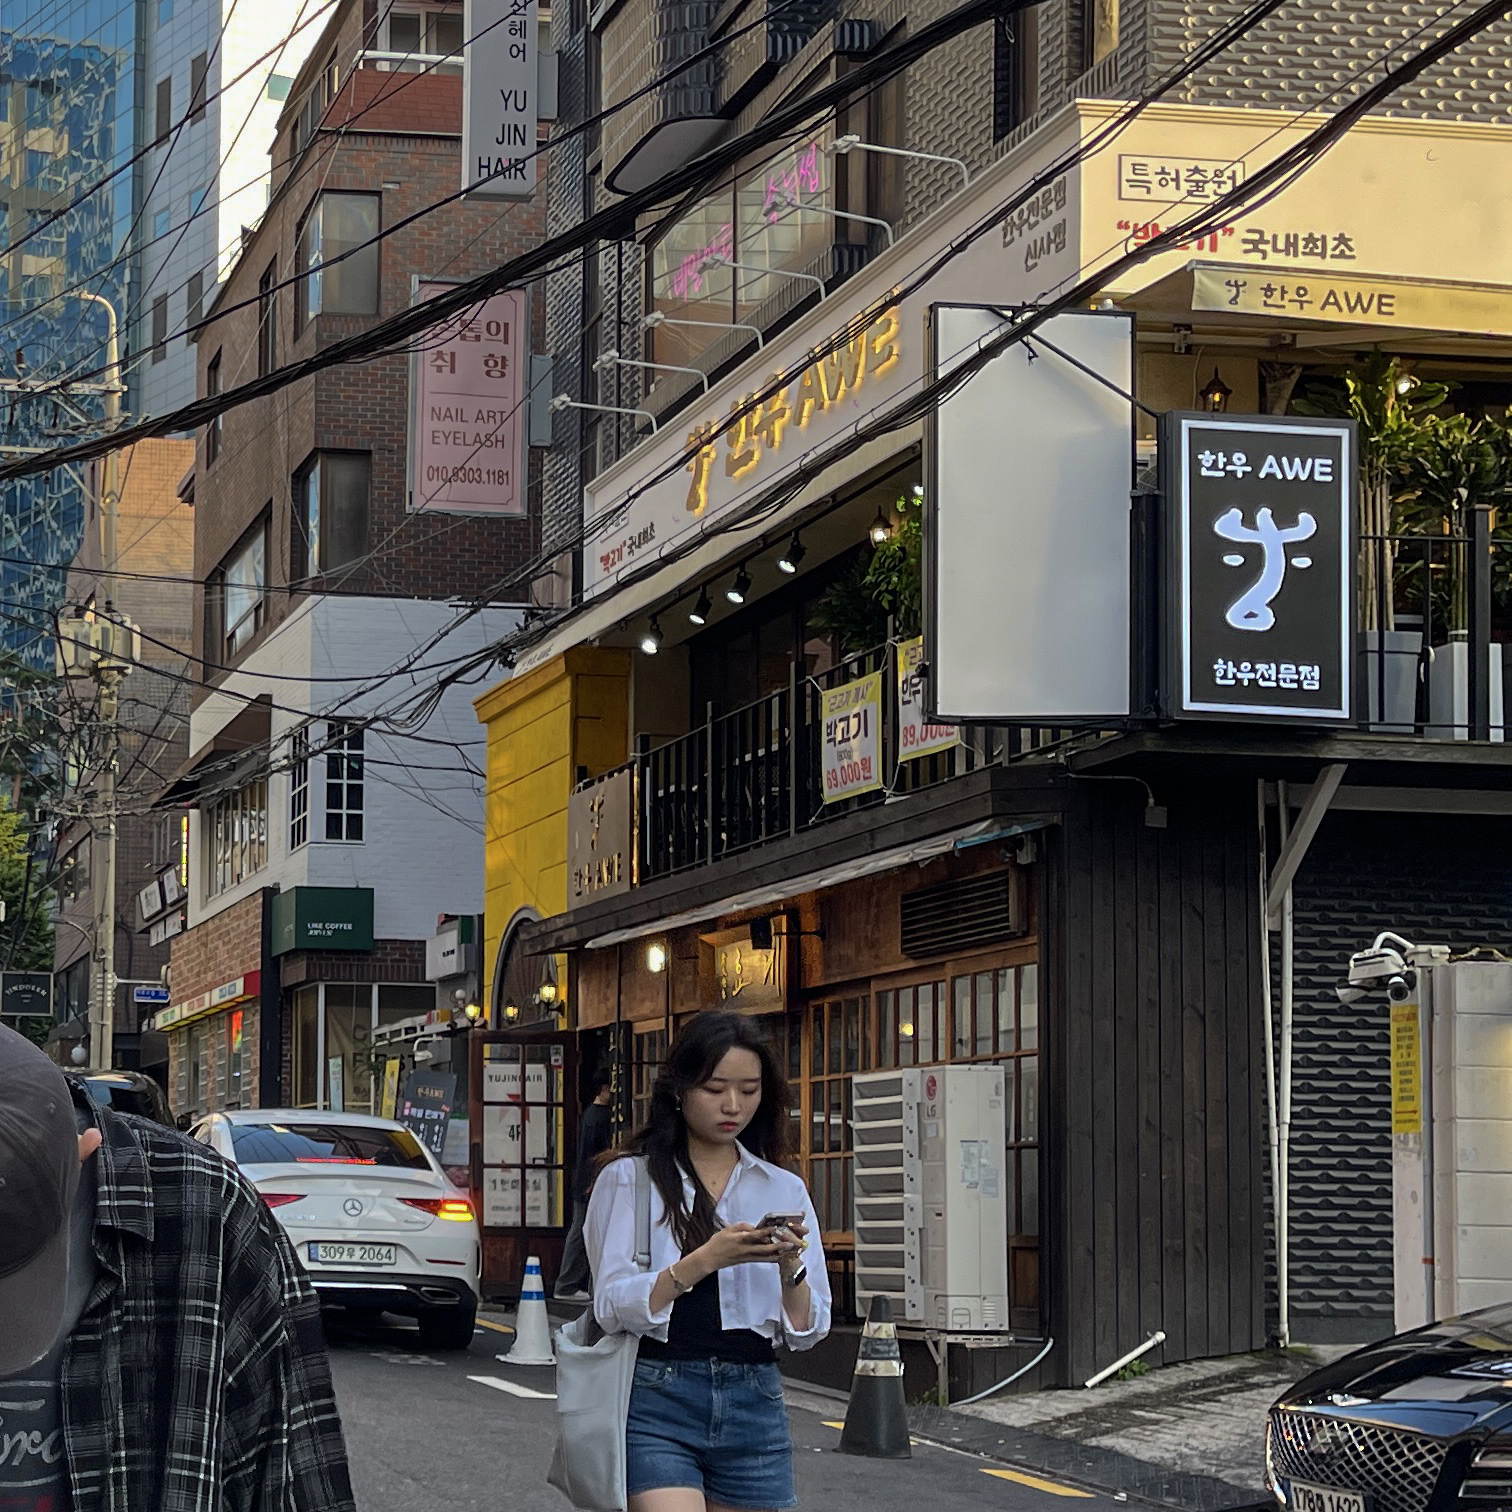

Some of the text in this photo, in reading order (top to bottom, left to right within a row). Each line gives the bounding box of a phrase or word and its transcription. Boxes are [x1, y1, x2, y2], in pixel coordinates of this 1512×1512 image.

[500, 89, 527, 112] YU
[495, 123, 526, 146] JIN
[477, 156, 527, 180] HAIR
[1125, 162, 1238, 198] 특허출원
[1024, 218, 1067, 273] 신사점
[1241, 228, 1356, 260] 국내최초
[1260, 283, 1396, 316] 한우 AWE
[431, 406, 507, 425] NAIL ART
[431, 430, 506, 449] EYELASH
[1197, 450, 1334, 482] 한우 AWE
[1213, 658, 1321, 690] 한우전문점
[826, 708, 869, 747] 박고기
[926, 1104, 937, 1118] LG
[359, 1247, 393, 1262] 2064
